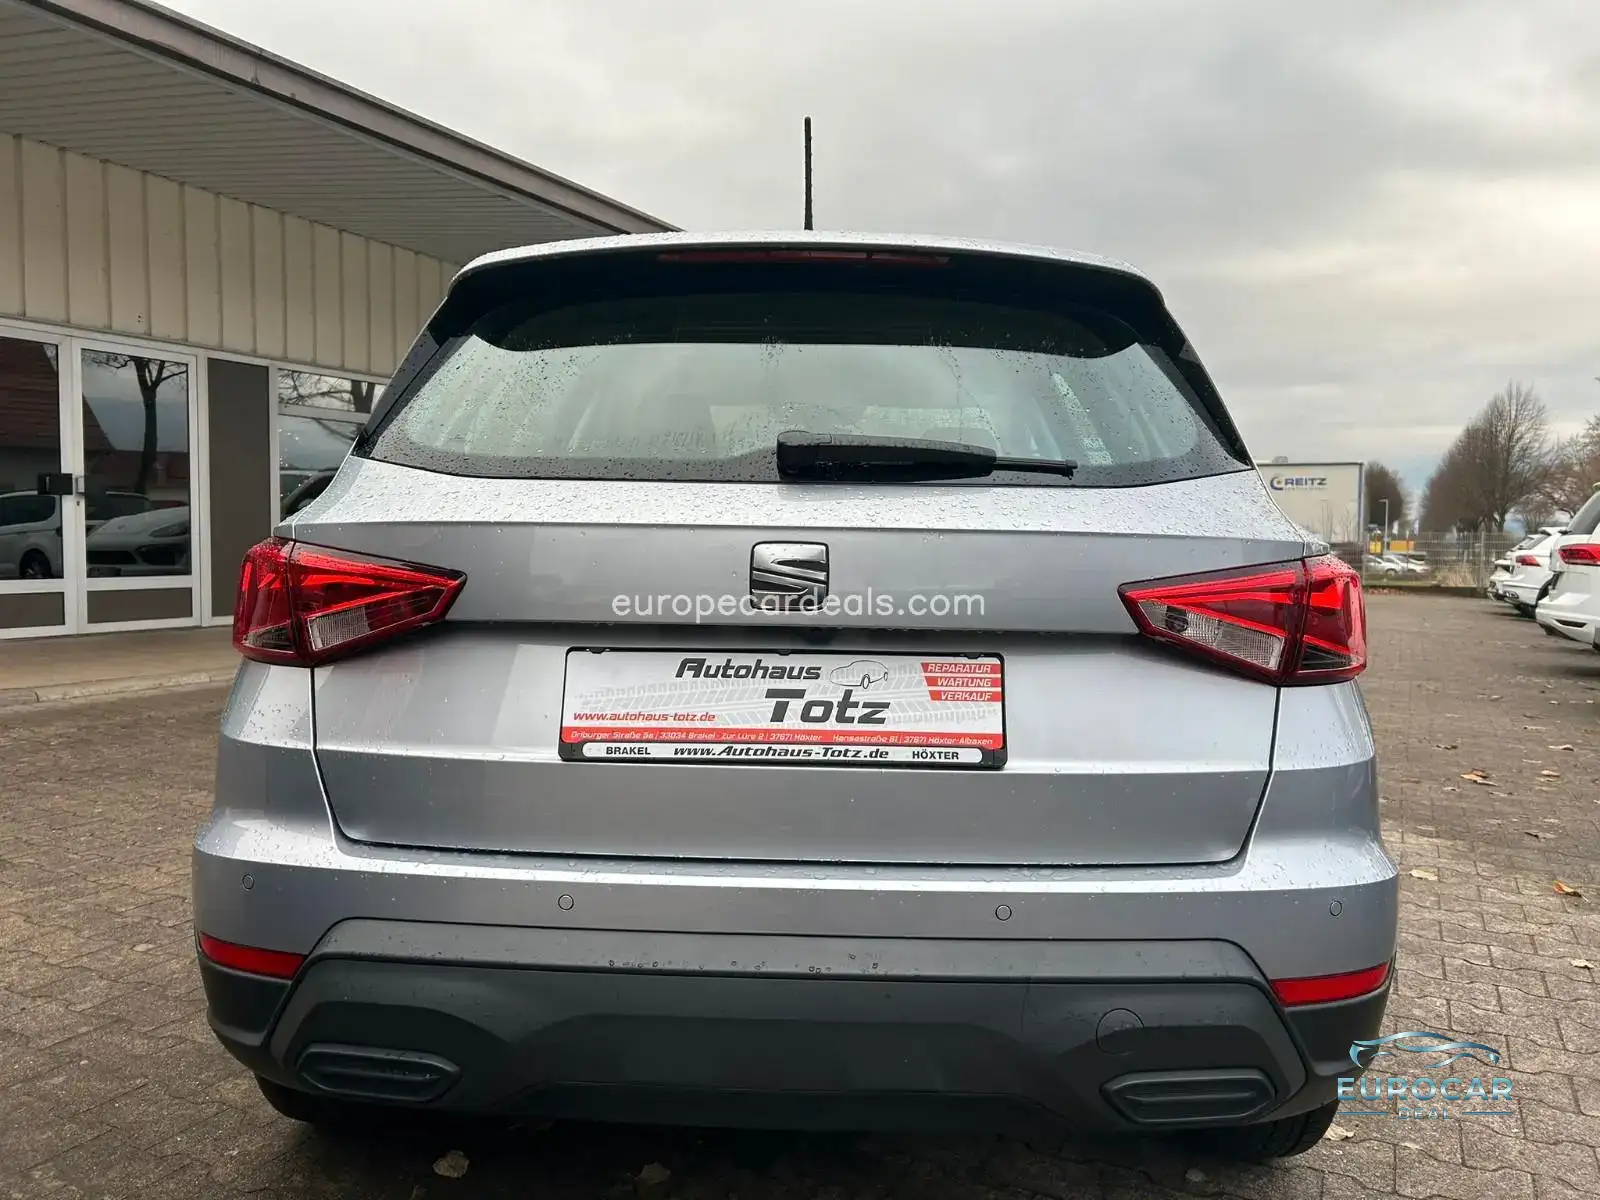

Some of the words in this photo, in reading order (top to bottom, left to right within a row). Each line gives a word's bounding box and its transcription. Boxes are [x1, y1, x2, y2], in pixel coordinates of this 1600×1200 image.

[1285, 477, 1328, 486] REITZ
[675, 658, 822, 680] Autohaus
[928, 663, 991, 673] REPARATUR
[937, 677, 992, 687] WARTUNG
[940, 691, 993, 701] VERKAUF
[765, 688, 891, 725] Totz
[573, 711, 717, 723] www.autohaus-totz.de
[605, 746, 652, 756] BRAKEL
[673, 745, 889, 759] www.Autohaus-Totz.de
[912, 749, 960, 761] HÖXTER
